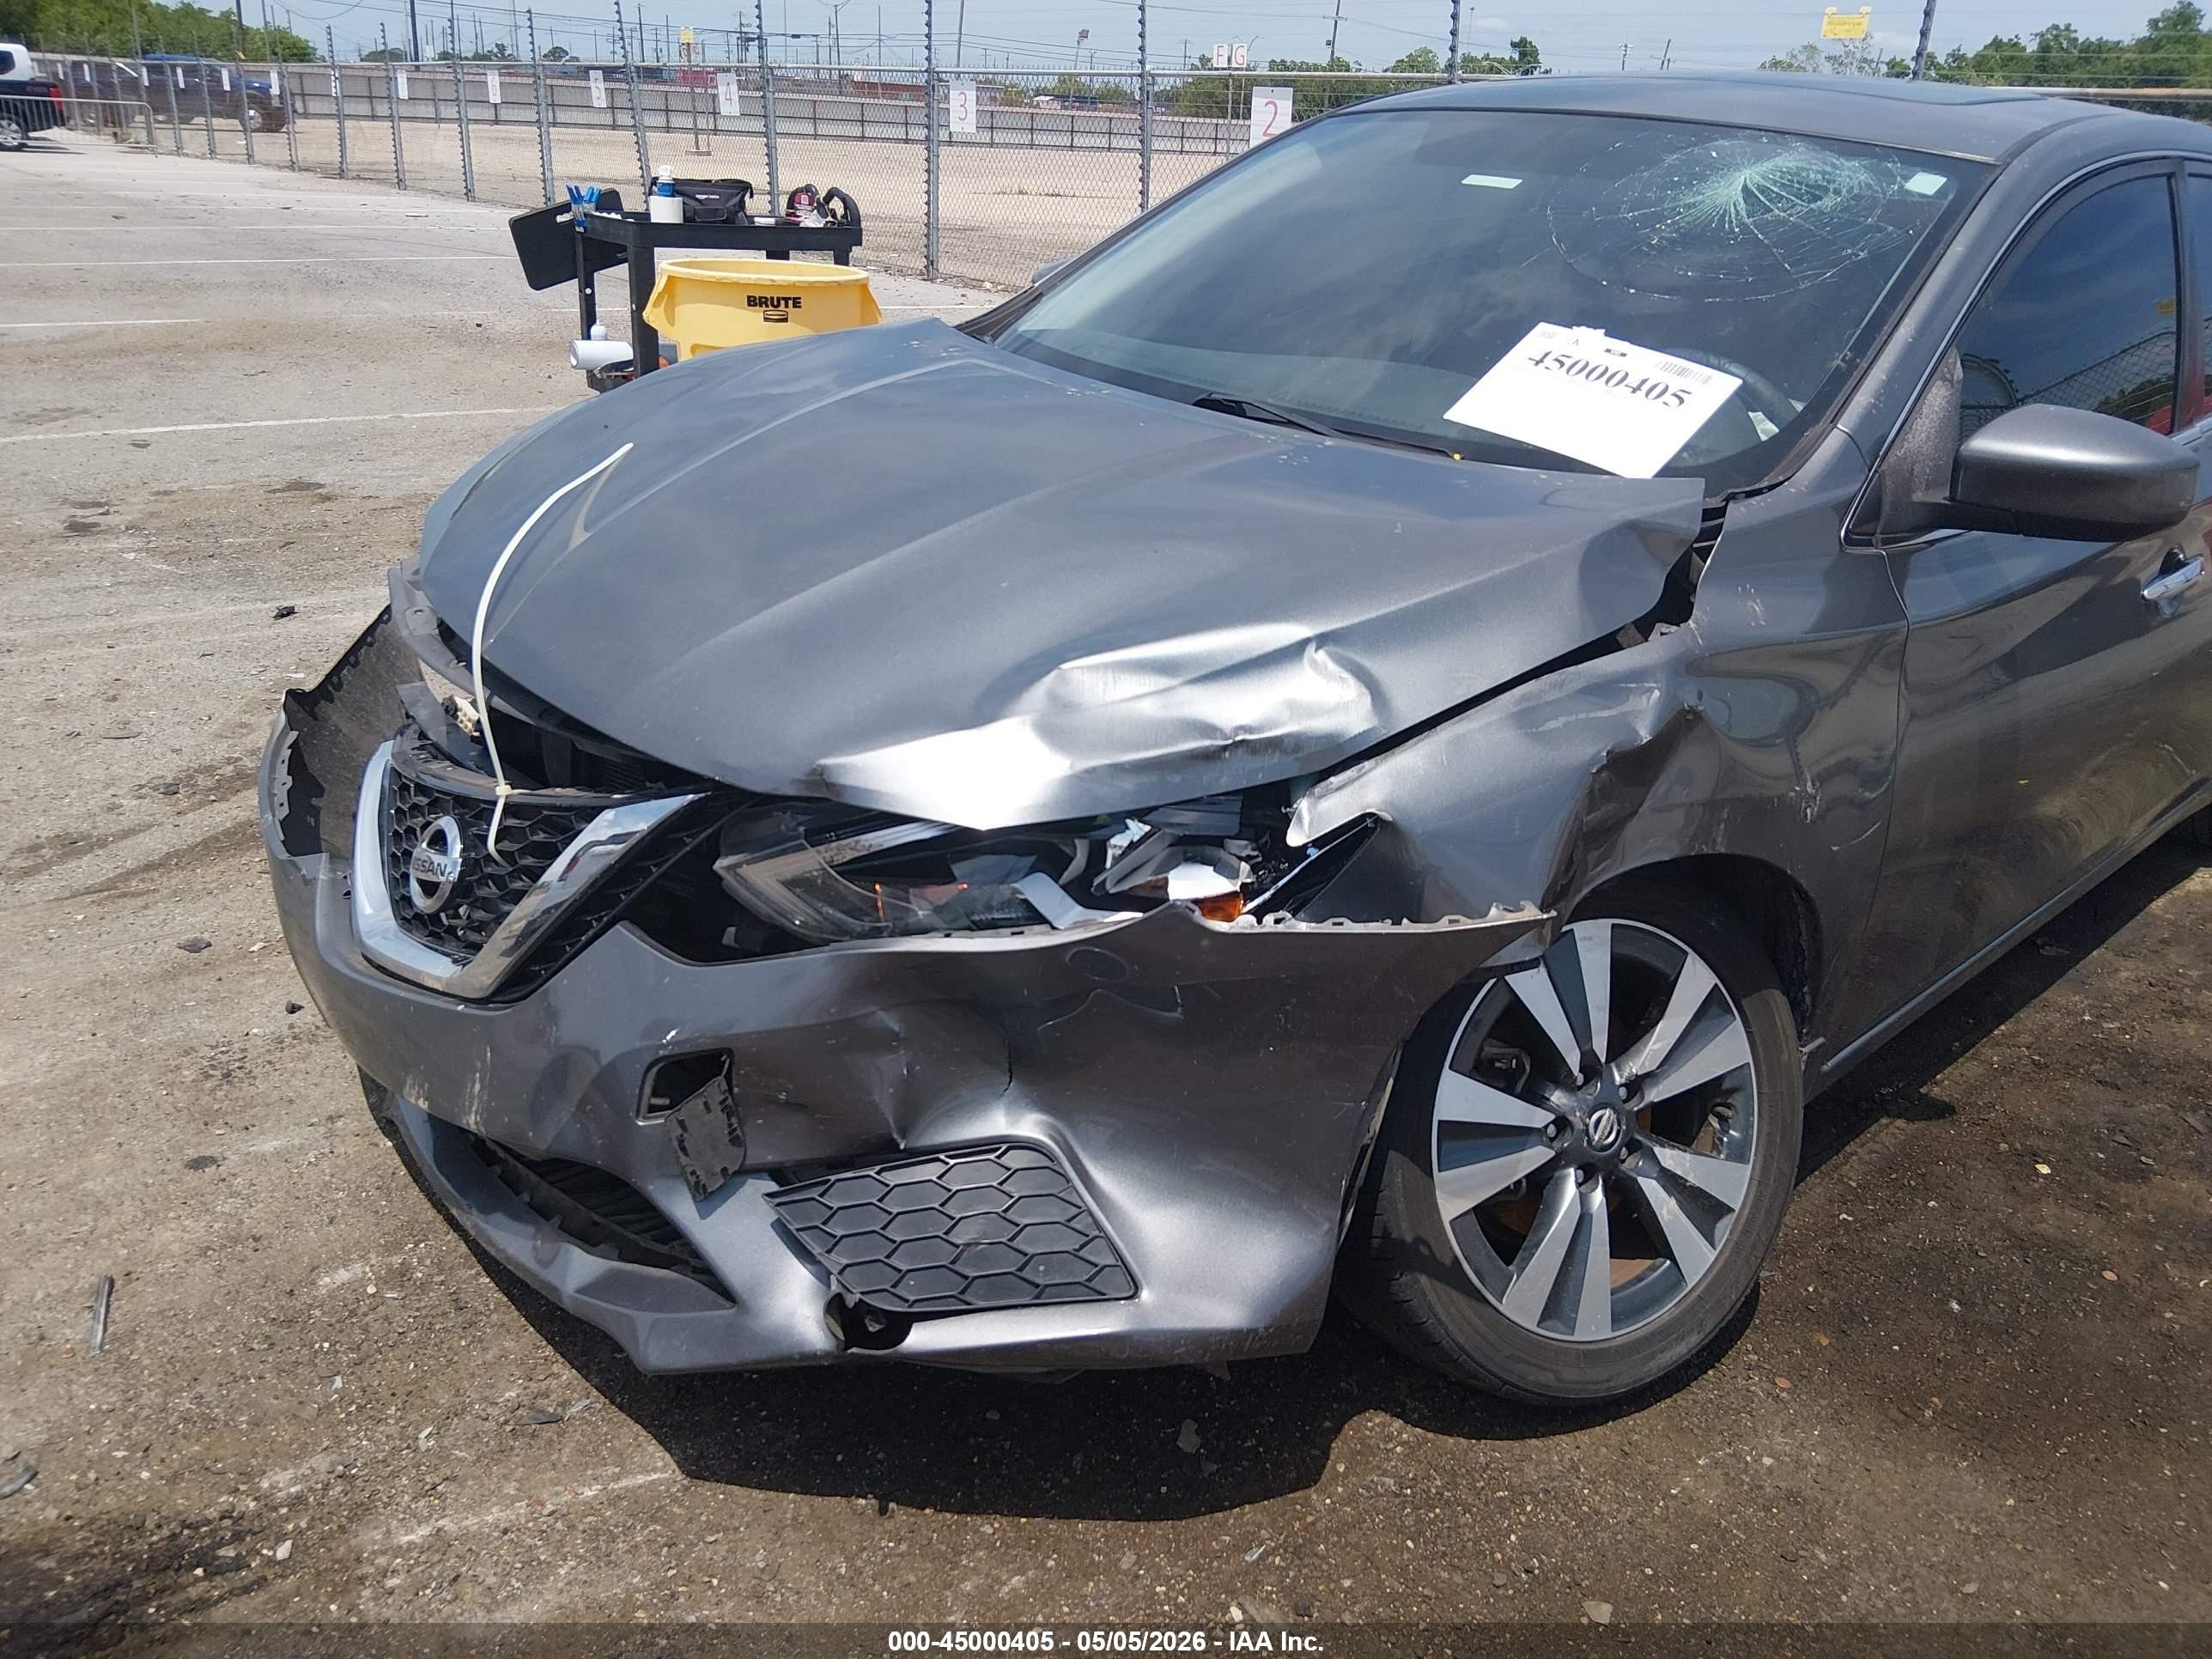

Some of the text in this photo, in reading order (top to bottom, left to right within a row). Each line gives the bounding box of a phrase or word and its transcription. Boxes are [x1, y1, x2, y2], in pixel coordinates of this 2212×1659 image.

[1216, 45, 1224, 65] F
[1234, 45, 1245, 66] G
[594, 77, 603, 100] 5
[725, 82, 733, 109] 4
[957, 91, 969, 122] 3
[1261, 100, 1279, 137] 2
[746, 295, 802, 309] BRUTE
[1527, 349, 1693, 408] 45000405
